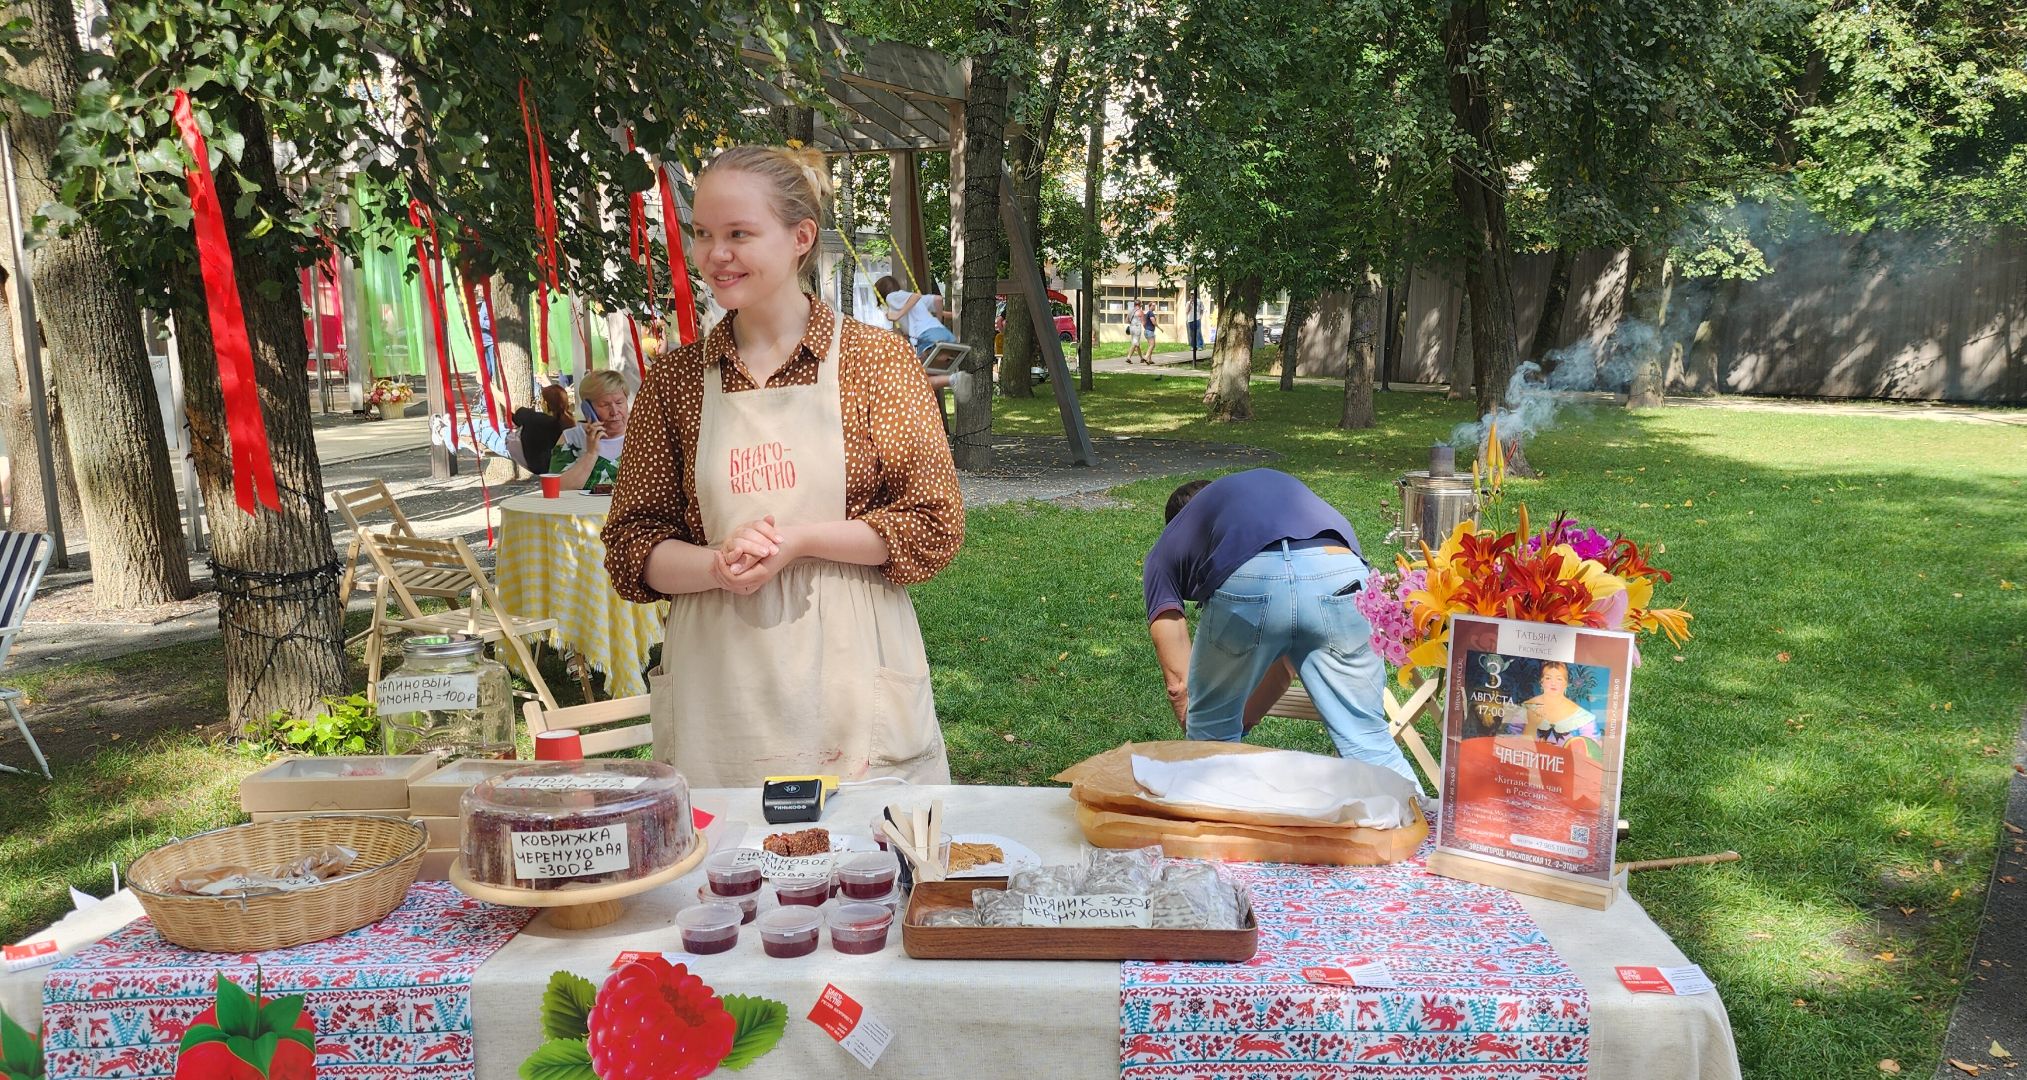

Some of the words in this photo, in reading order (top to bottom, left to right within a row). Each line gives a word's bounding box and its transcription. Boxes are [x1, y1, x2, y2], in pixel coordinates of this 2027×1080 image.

[731, 441, 792, 478] БЛАГО-
[731, 460, 796, 494] ВЕСТНО
[1484, 662, 1502, 689] 3
[377, 689, 433, 706] ИМОНАД
[1470, 690, 1515, 706] АВГУСТА
[1478, 704, 1505, 718] 17:00
[1495, 745, 1565, 774] ЧАЕПИТИЕ
[520, 827, 611, 847] КОВРИЖКА
[516, 842, 621, 864] ЧЕРЕМУХОВАЯ
[1028, 895, 1093, 912] ПРЯНИК
